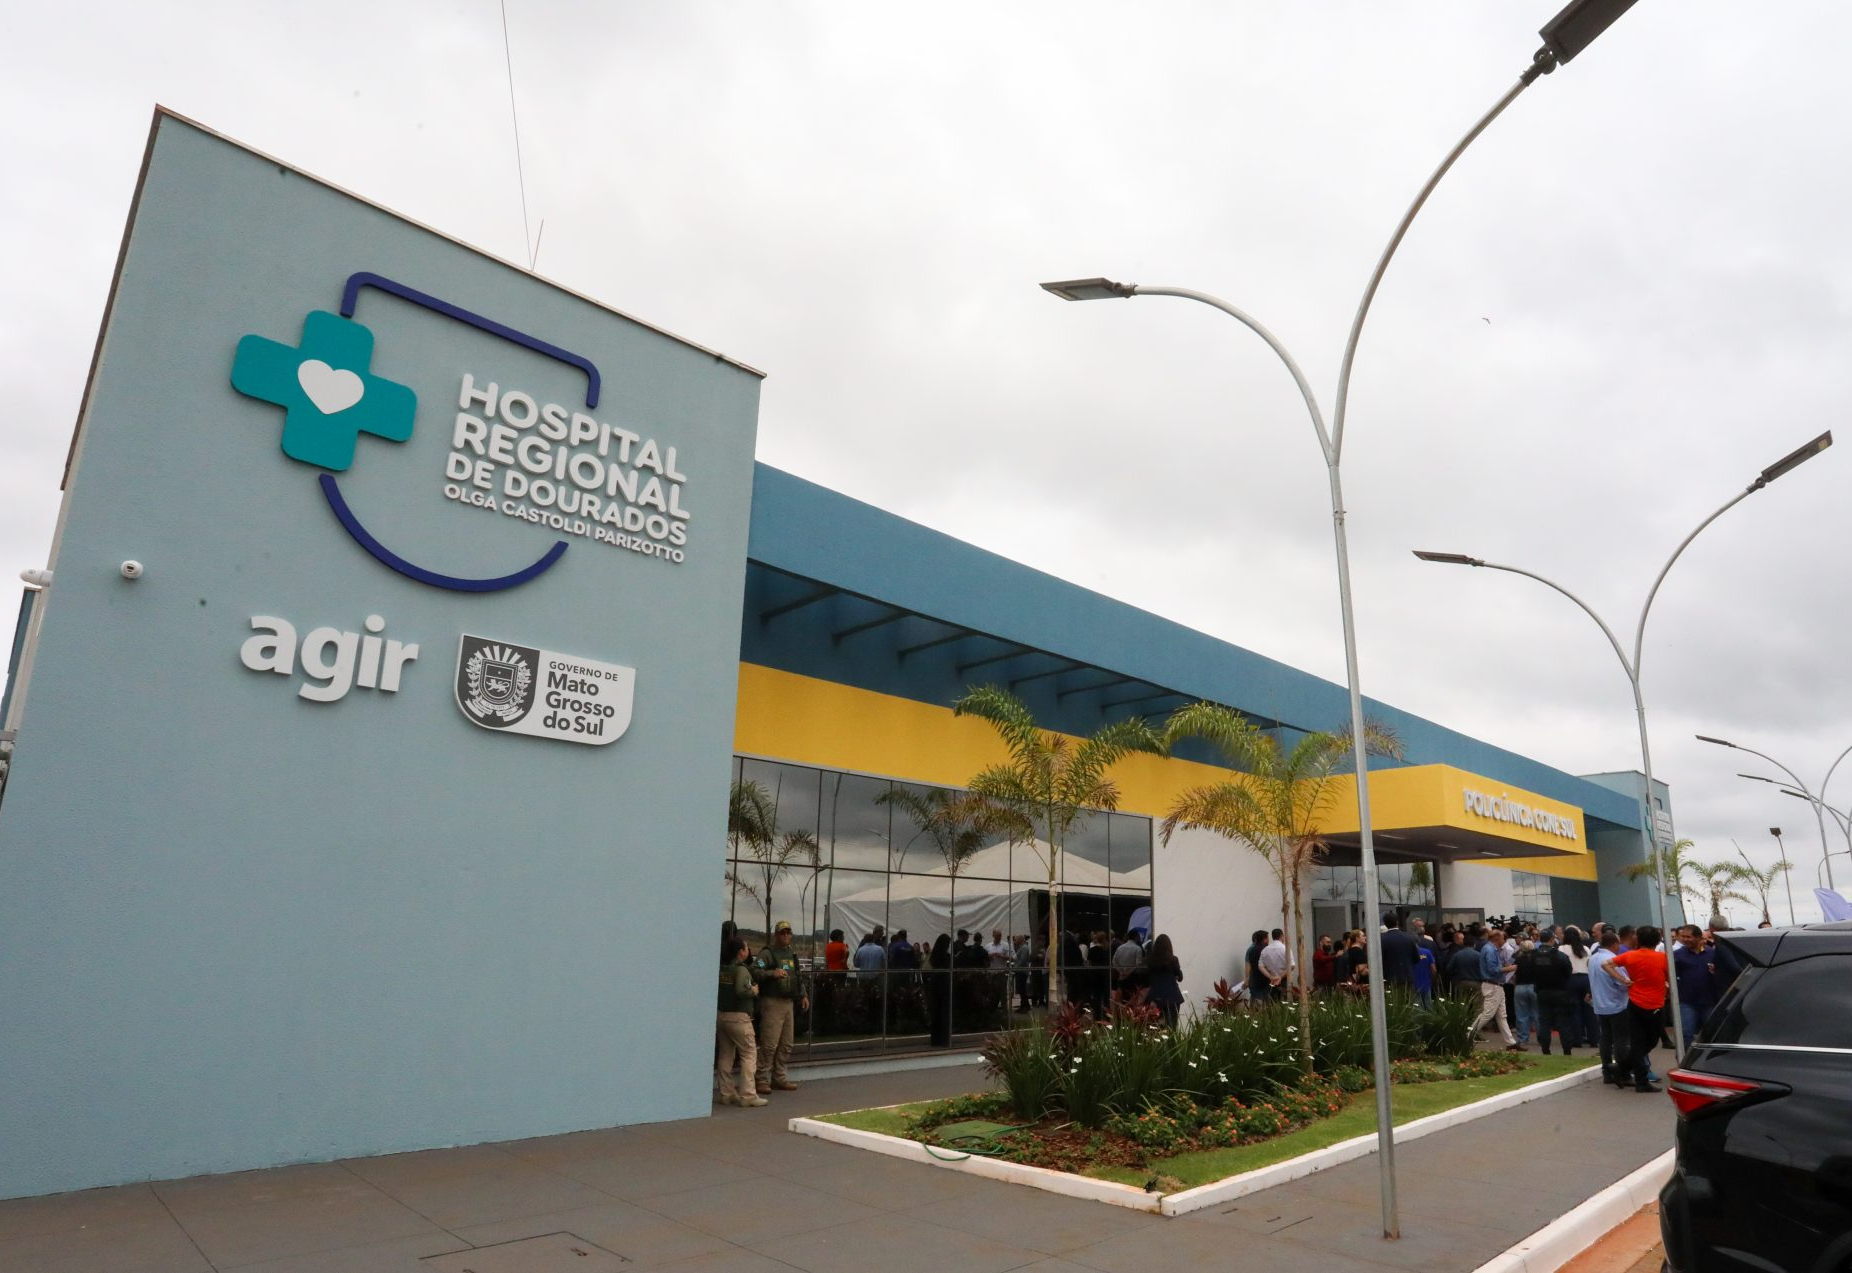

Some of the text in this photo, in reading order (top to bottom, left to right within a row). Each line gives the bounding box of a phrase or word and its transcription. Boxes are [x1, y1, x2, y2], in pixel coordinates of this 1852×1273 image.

[459, 373, 686, 483] HOSPITAL
[446, 451, 687, 545] DE DOURADOS
[453, 412, 690, 520] REGIONAL
[444, 483, 684, 563] OLGA CASTOLDI PARIZOTTO
[240, 614, 420, 702] agir
[547, 670, 599, 696] Mato
[549, 661, 619, 682] GOVERNO DE
[543, 710, 604, 736] do Sul
[545, 690, 615, 718] Grosso
[1463, 788, 1577, 840] POLICLÍNICA CONE SUL
